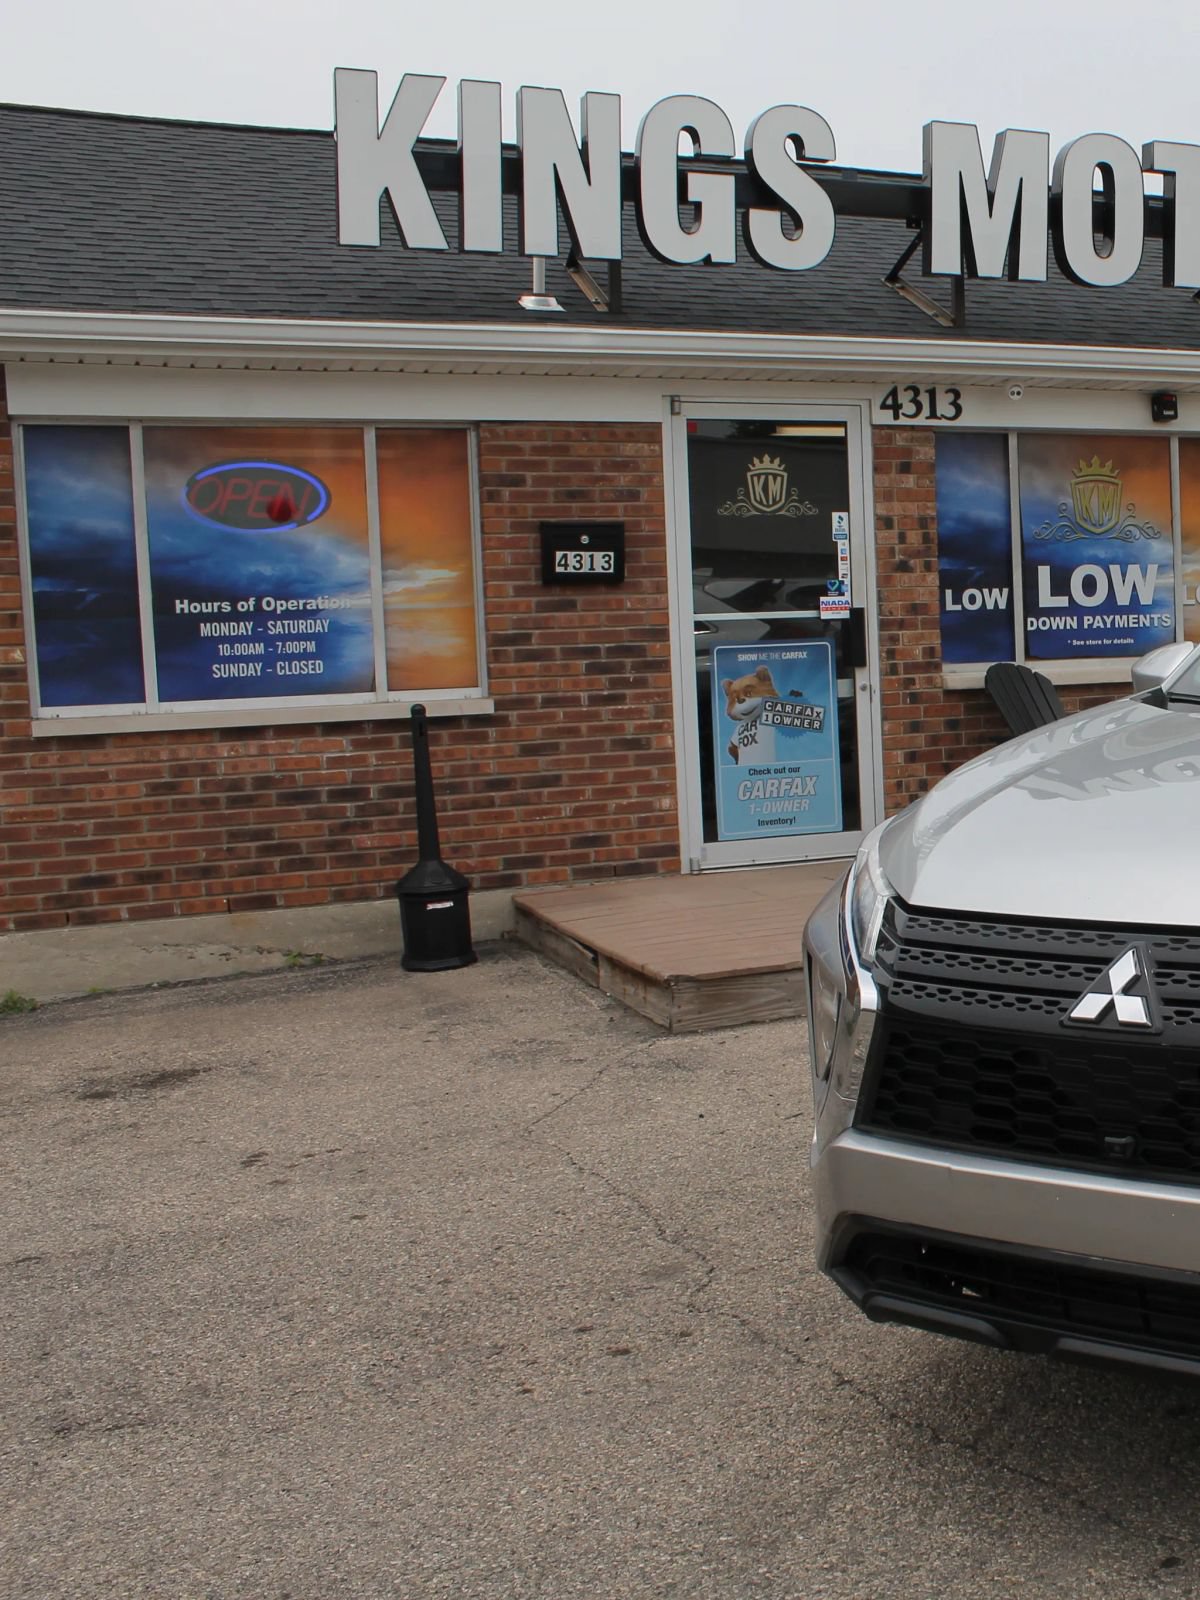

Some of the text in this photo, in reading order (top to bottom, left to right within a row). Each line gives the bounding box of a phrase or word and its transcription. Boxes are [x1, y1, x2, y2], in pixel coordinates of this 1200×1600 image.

[334, 67, 837, 271] KINGS
[880, 385, 963, 421] 4313
[190, 477, 312, 519] OPEN
[557, 553, 612, 571] 4313
[1037, 563, 1158, 608] LOW
[175, 595, 351, 615] Hours of Operation
[945, 587, 1009, 611] LOW
[200, 621, 254, 637] MONDAY
[267, 618, 330, 635] SATURDAY
[1026, 613, 1172, 631] DOWN PAYMENTS
[218, 642, 265, 656] 10:00AM
[276, 641, 316, 654] 7:00PM
[1086, 638, 1102, 646] store
[1113, 637, 1135, 645] details
[737, 653, 758, 662] SHOW
[781, 651, 808, 660] CARFAX
[212, 662, 263, 678] SUNDAY
[276, 660, 324, 676] CLOSED
[764, 701, 822, 719] CARFAX
[738, 720, 758, 736] CAR
[738, 732, 759, 747] FOX
[748, 767, 772, 776] Check
[773, 766, 786, 775] out
[737, 775, 819, 801] CARFAX
[757, 816, 796, 827] Inventory!
